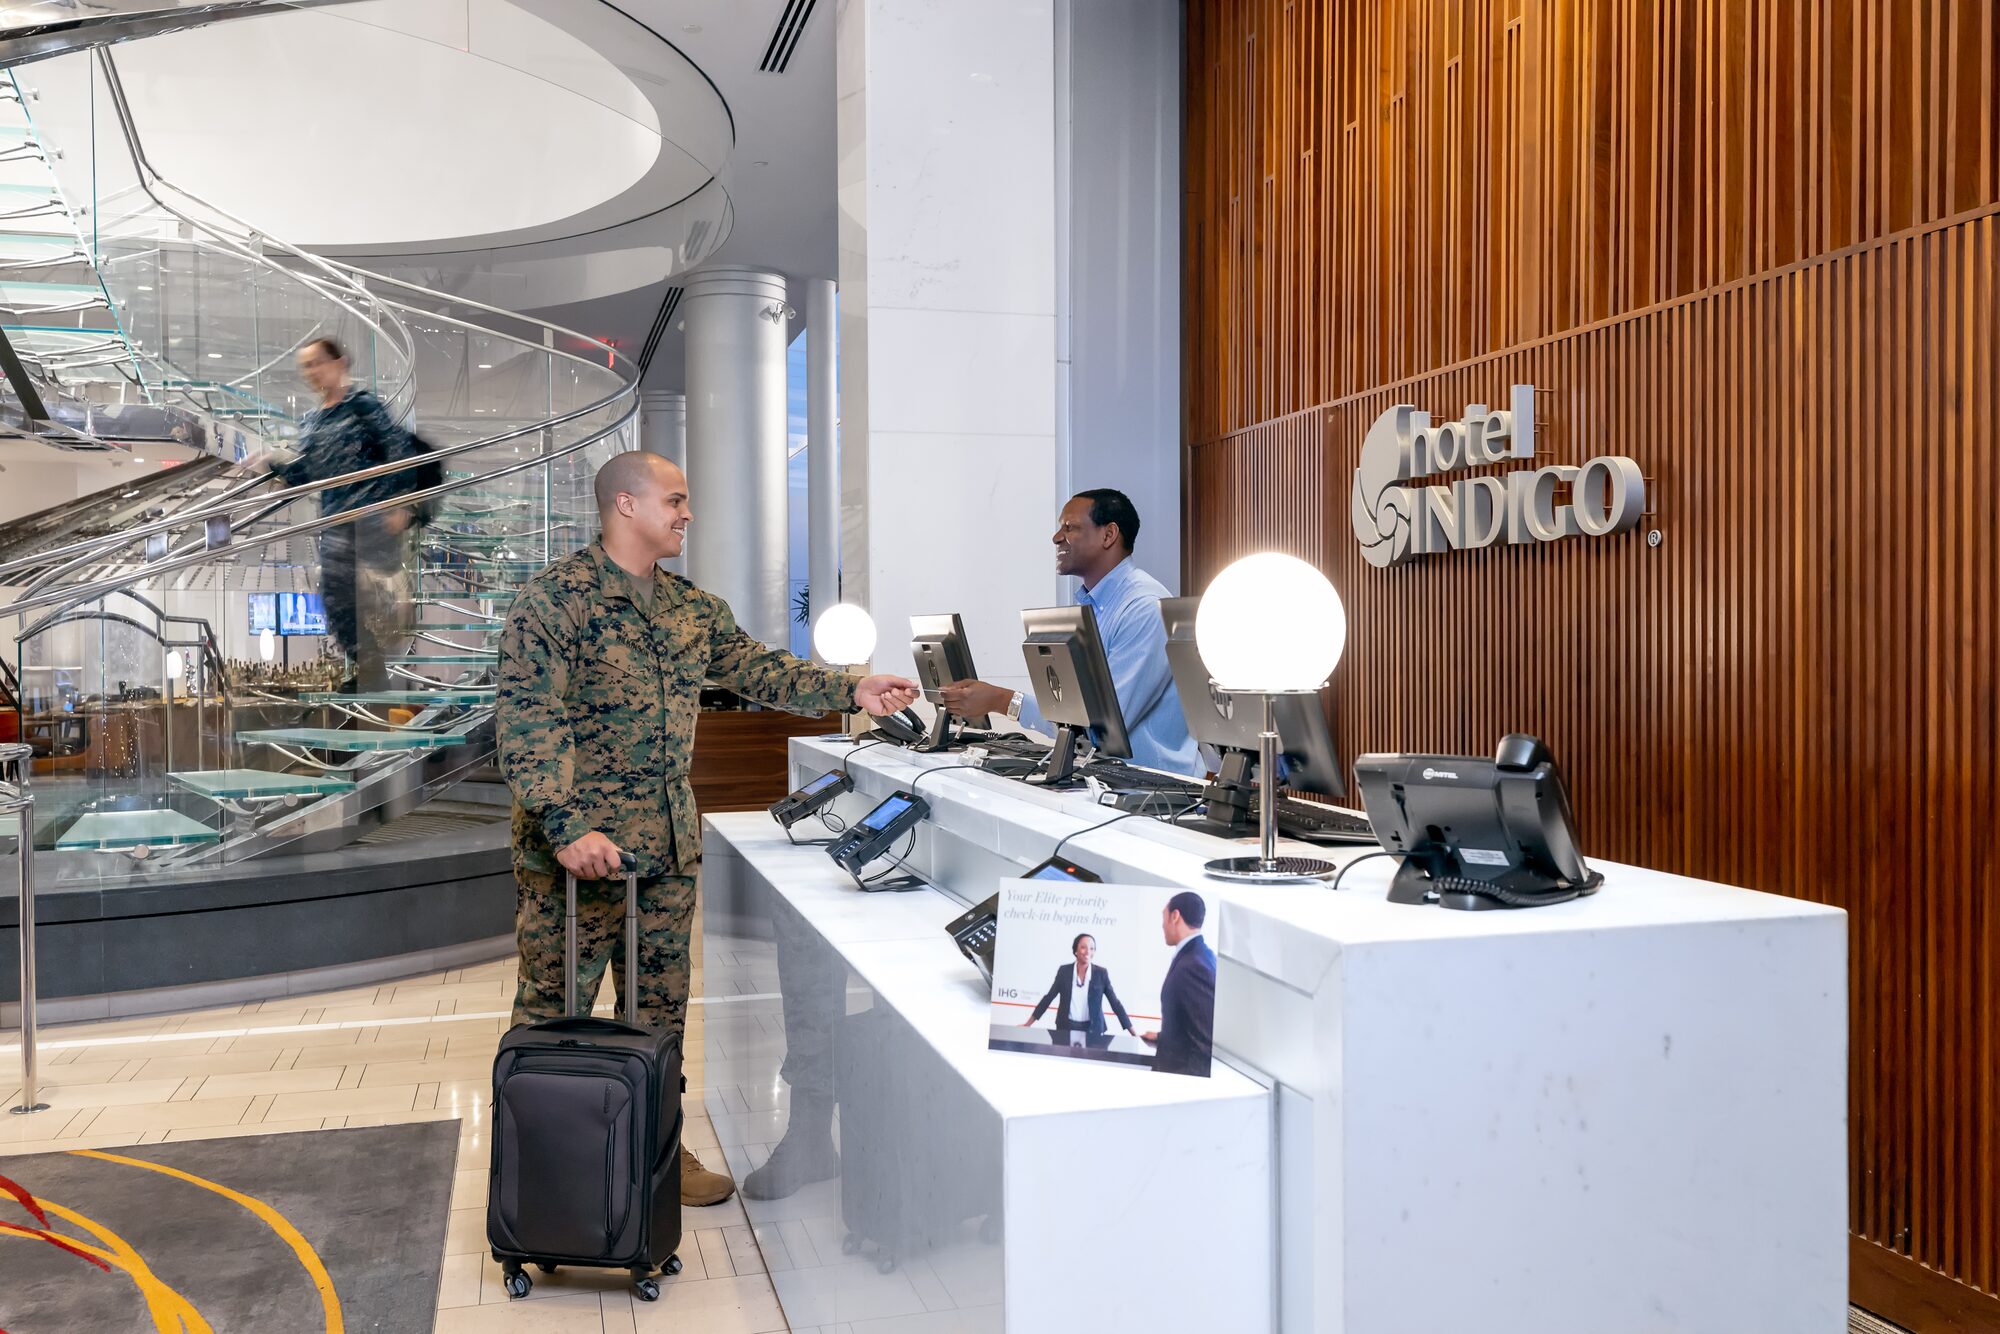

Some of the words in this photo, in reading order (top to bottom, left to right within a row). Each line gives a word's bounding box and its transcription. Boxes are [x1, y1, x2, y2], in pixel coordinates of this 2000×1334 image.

[1410, 384, 1534, 478] hotel
[1410, 456, 1645, 554] INDIGO
[1006, 889, 1034, 902] Your
[1034, 891, 1062, 906] Elite
[1063, 895, 1108, 911] priority
[1003, 907, 1051, 922] check-in
[1052, 910, 1090, 926] begins
[1091, 913, 1118, 927] here
[998, 988, 1018, 999] IHG
